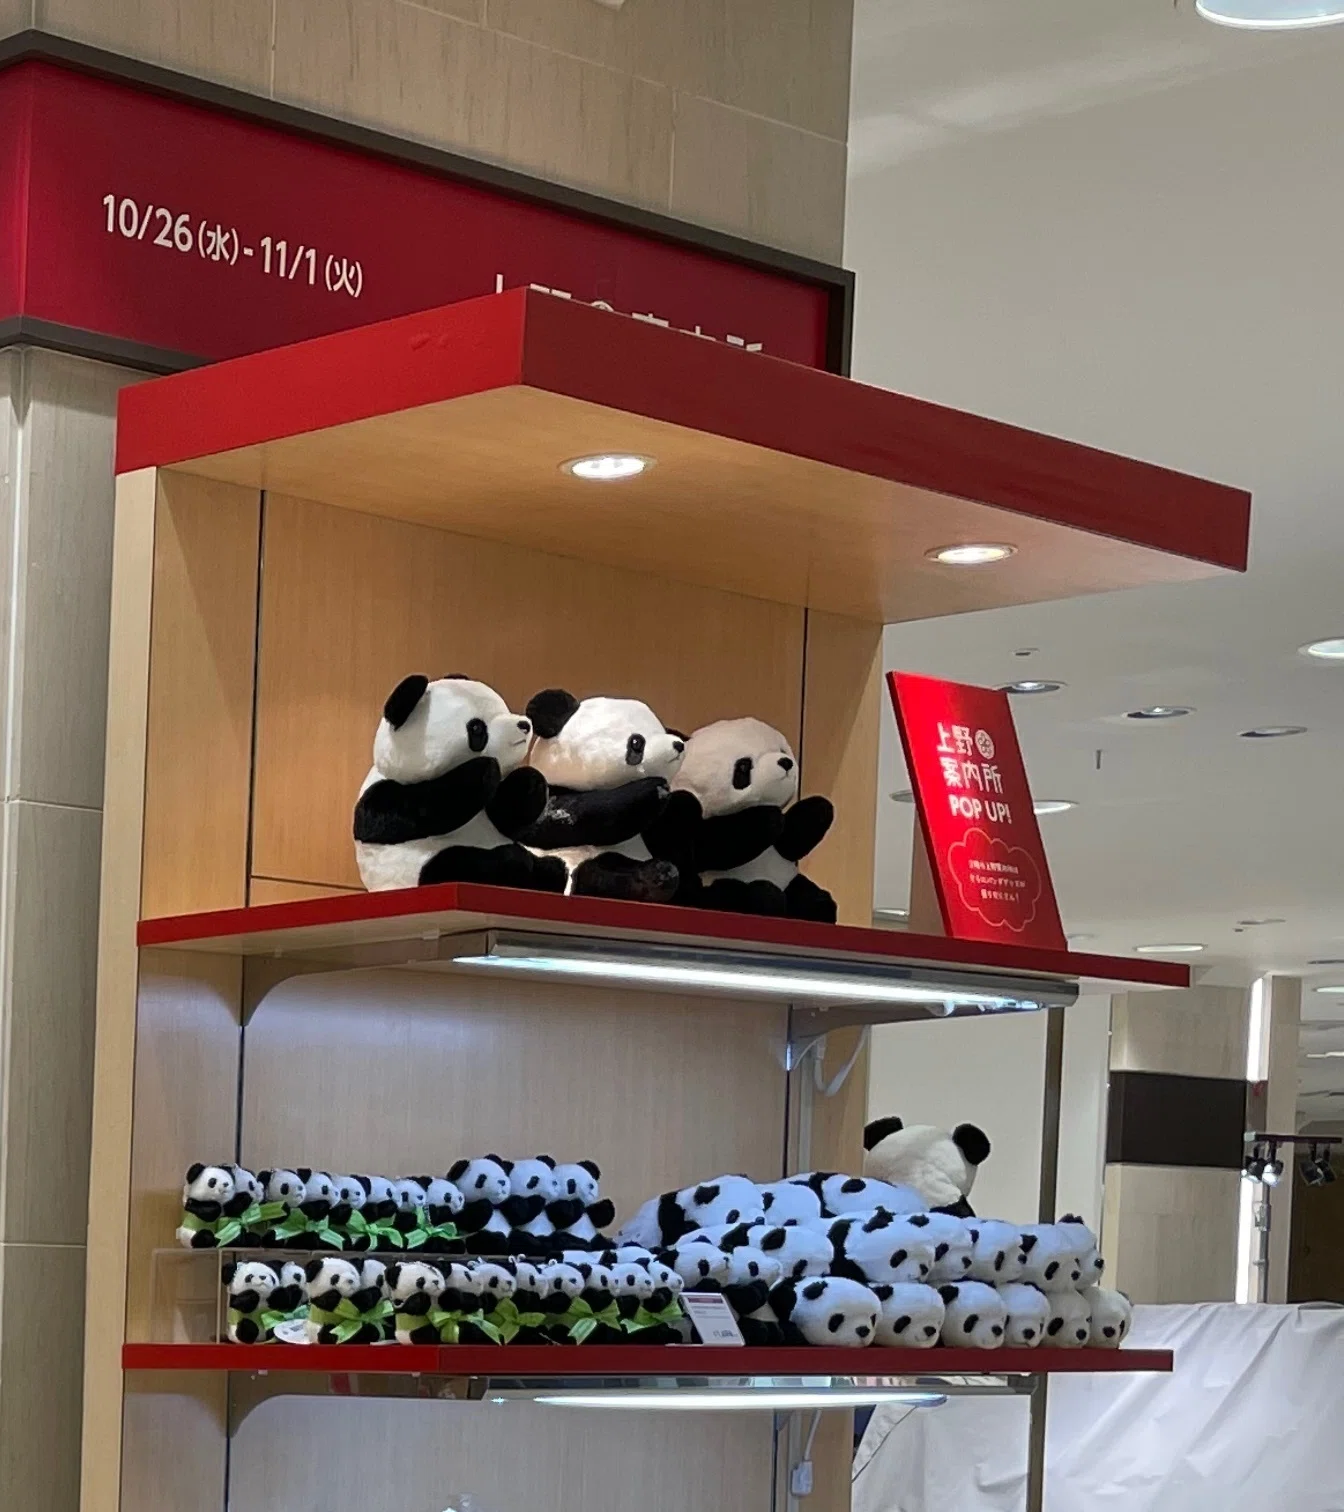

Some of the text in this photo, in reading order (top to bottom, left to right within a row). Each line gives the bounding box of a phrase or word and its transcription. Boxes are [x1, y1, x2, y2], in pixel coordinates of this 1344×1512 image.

[937, 722, 974, 757] 上野
[940, 757, 1004, 794] 案内所
[949, 794, 1012, 824] POP UP!
